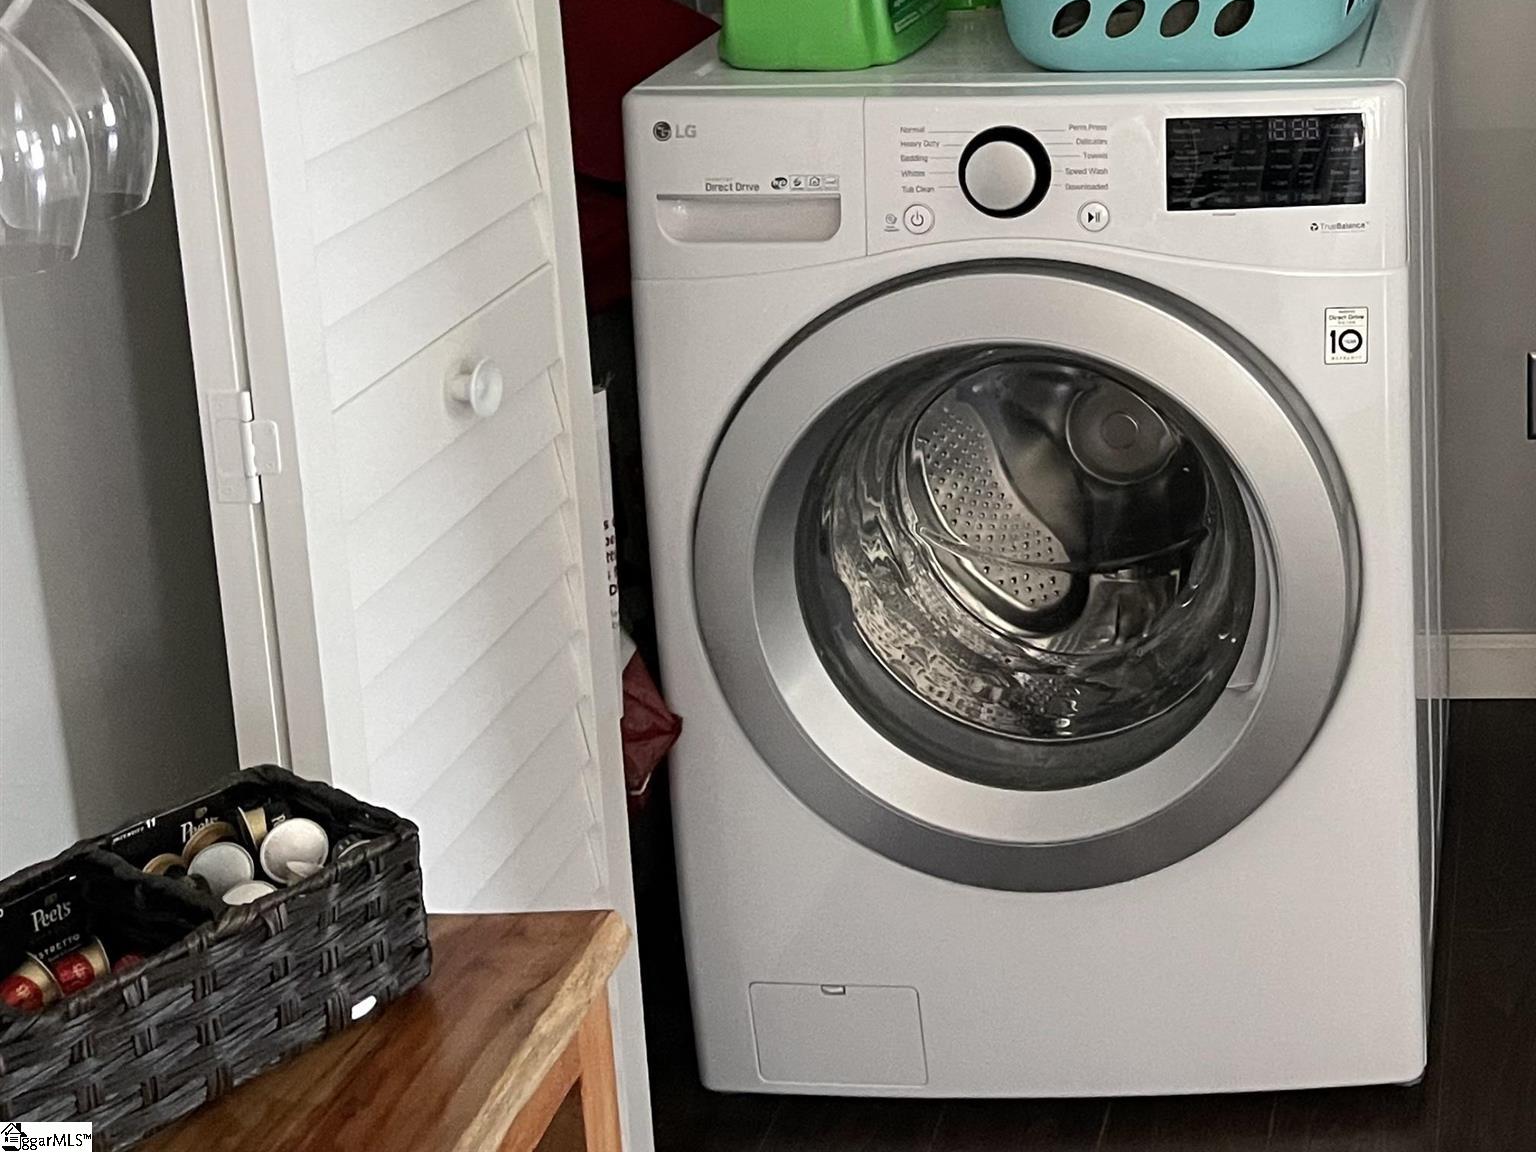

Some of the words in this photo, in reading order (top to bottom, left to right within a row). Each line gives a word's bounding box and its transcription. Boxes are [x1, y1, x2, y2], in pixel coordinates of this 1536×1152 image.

[674, 125, 697, 139] LG
[705, 182, 733, 192] Direct
[735, 182, 760, 192] Drive
[1330, 328, 1363, 354] 10
